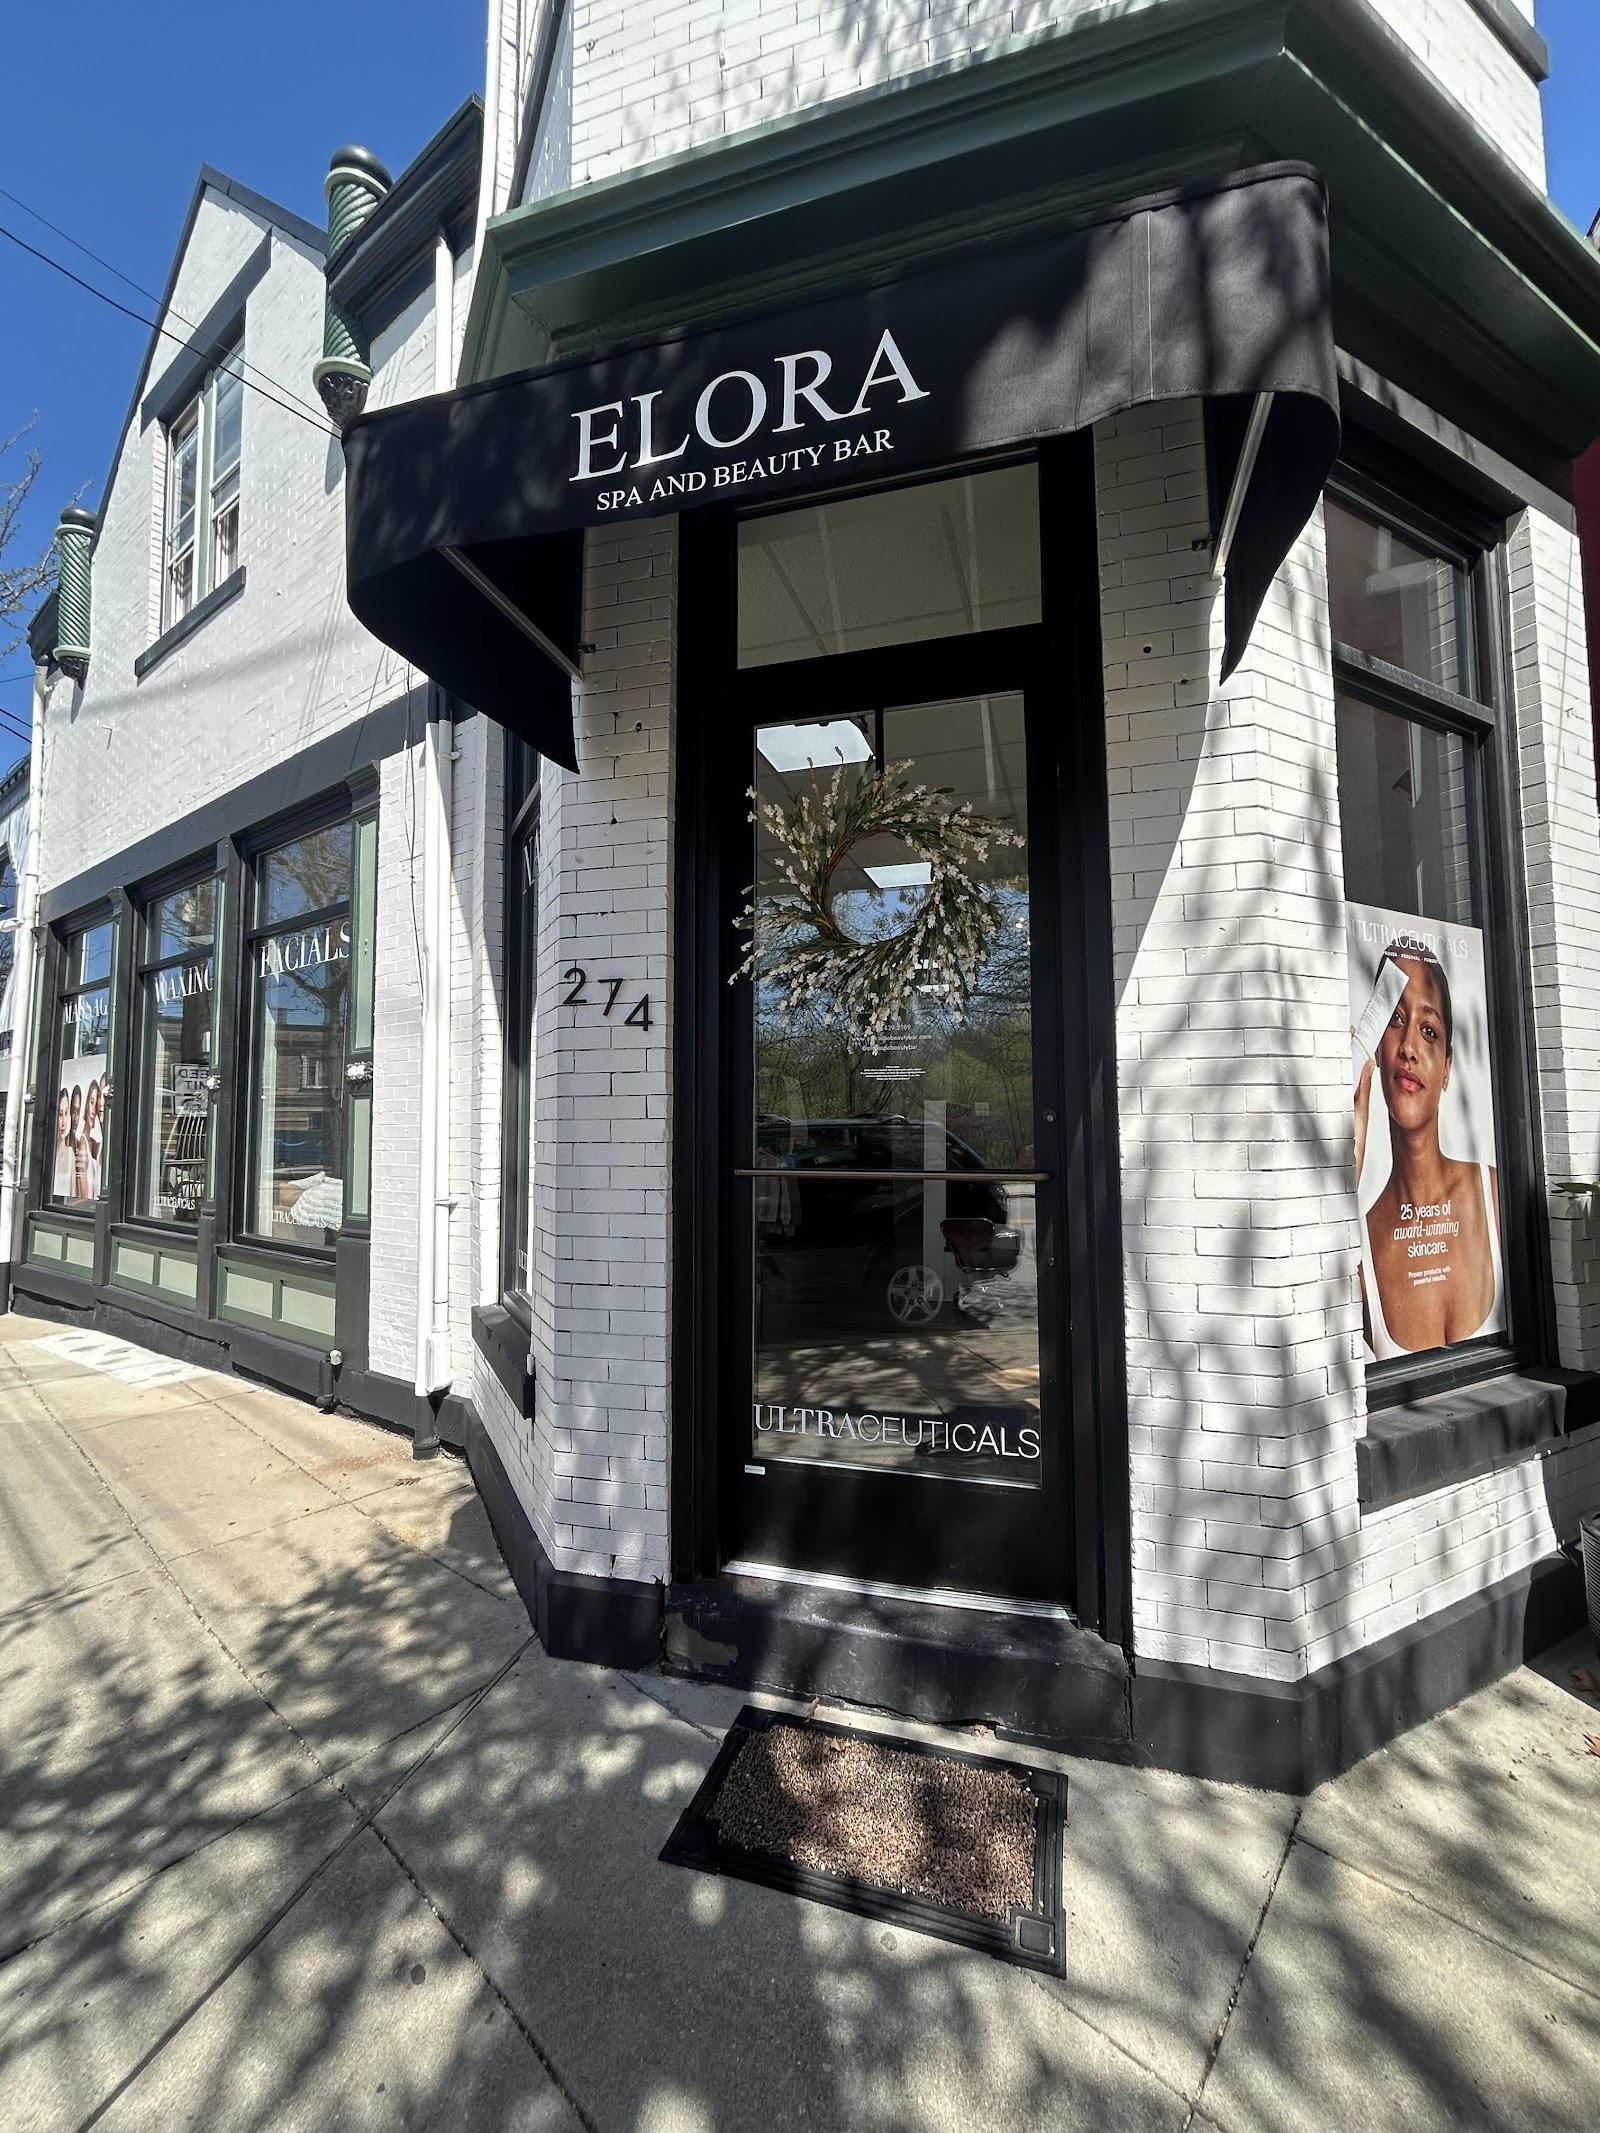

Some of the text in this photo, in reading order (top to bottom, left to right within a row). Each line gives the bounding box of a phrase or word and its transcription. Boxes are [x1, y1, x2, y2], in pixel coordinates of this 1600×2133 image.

[568, 328, 931, 482] ELORA
[597, 428, 895, 511] SPA AND BEAUTY BAR
[259, 921, 350, 978] FACIALS
[1351, 918, 1469, 960] ULTRACEUTICALS
[153, 963, 214, 1004] WAXING
[562, 967, 654, 1032] 274
[63, 997, 109, 1025] MASSAG
[1394, 1219, 1459, 1240] award-winning
[1401, 1200, 1451, 1222] 25 years of
[1408, 1241, 1448, 1257] skincare.
[752, 1403, 1041, 1459] ULTRACEUTICALS
